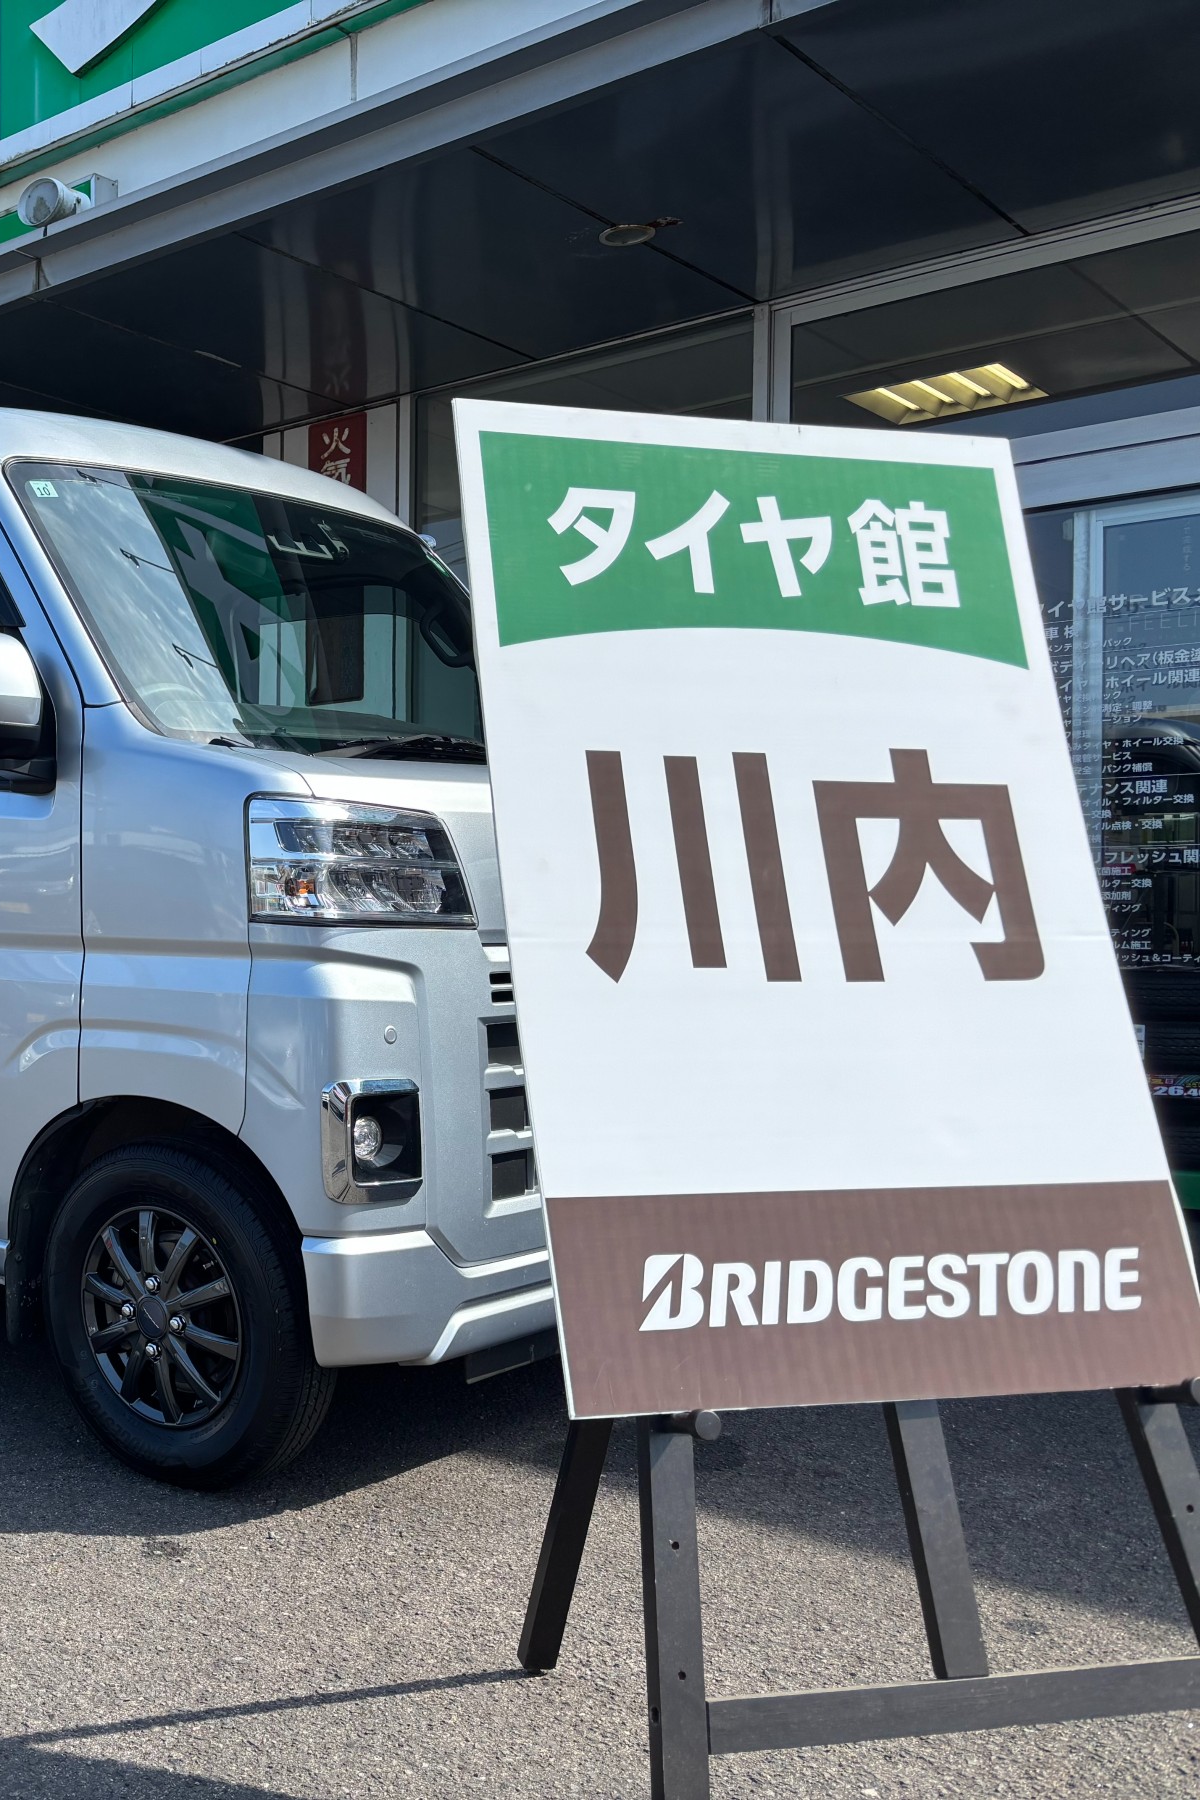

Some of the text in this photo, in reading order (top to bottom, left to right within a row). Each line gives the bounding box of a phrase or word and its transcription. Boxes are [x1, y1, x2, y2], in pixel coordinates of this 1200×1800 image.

[320, 427, 351, 485] 火気
[546, 486, 962, 609] タイヤ館
[1040, 586, 1200, 618] イヤ館サービス
[1069, 736, 1184, 751] みタイヤ・ホイール交換
[585, 748, 1046, 985] 川内
[638, 1246, 1143, 1332] BRIDGESTONE
